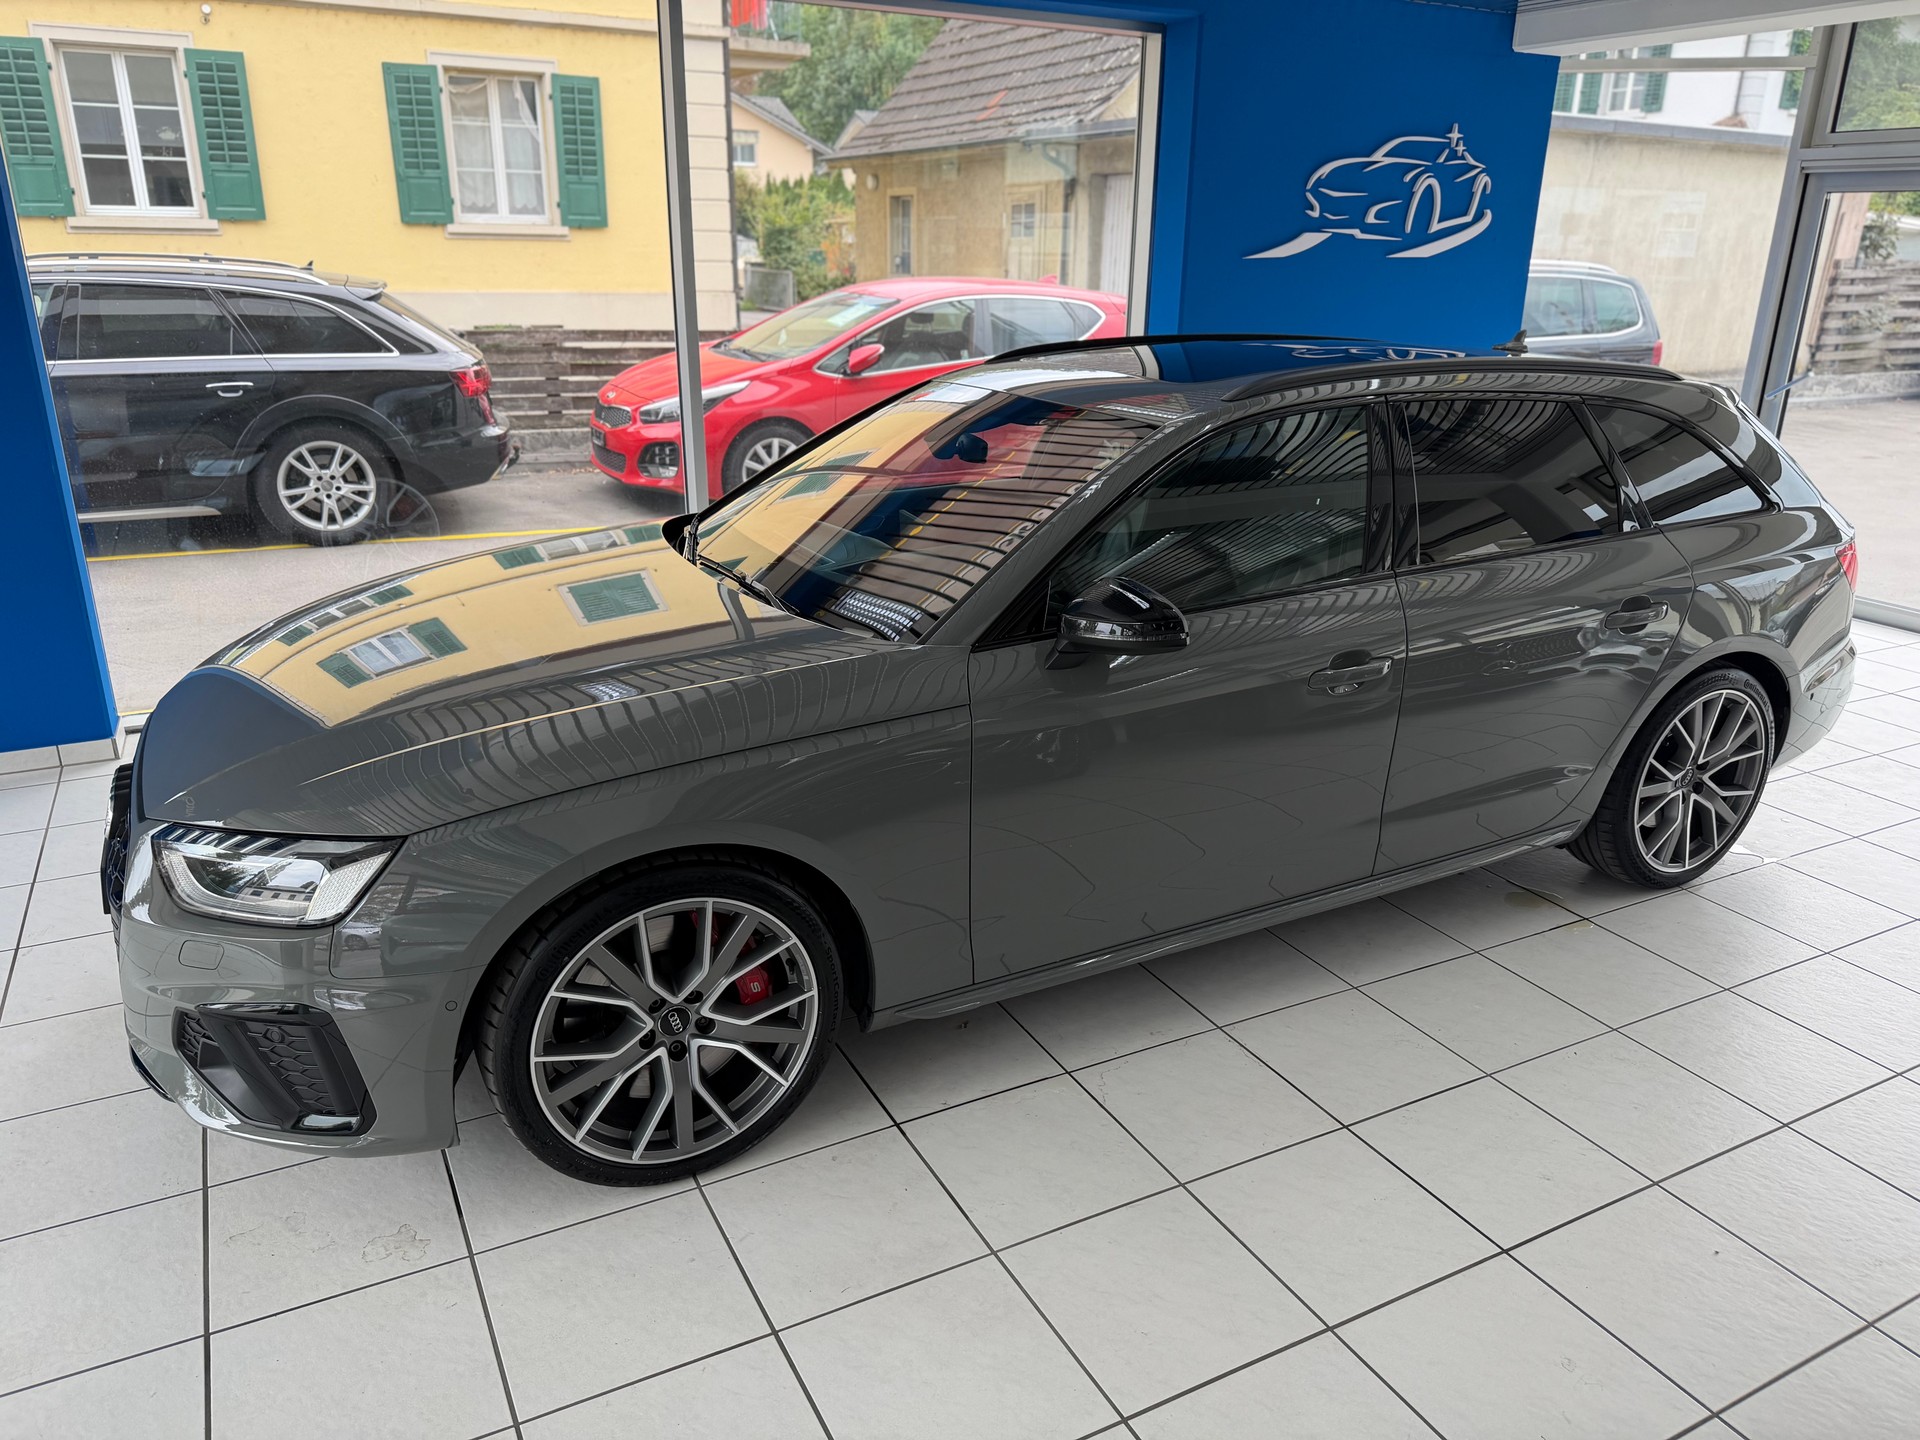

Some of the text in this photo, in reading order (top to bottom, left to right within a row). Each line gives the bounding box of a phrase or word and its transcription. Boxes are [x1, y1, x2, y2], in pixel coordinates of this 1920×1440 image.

[1744, 678, 1769, 708] Continental
[535, 912, 601, 983] Continental
[750, 981, 761, 992] S
[825, 946, 840, 1032] SportContact
